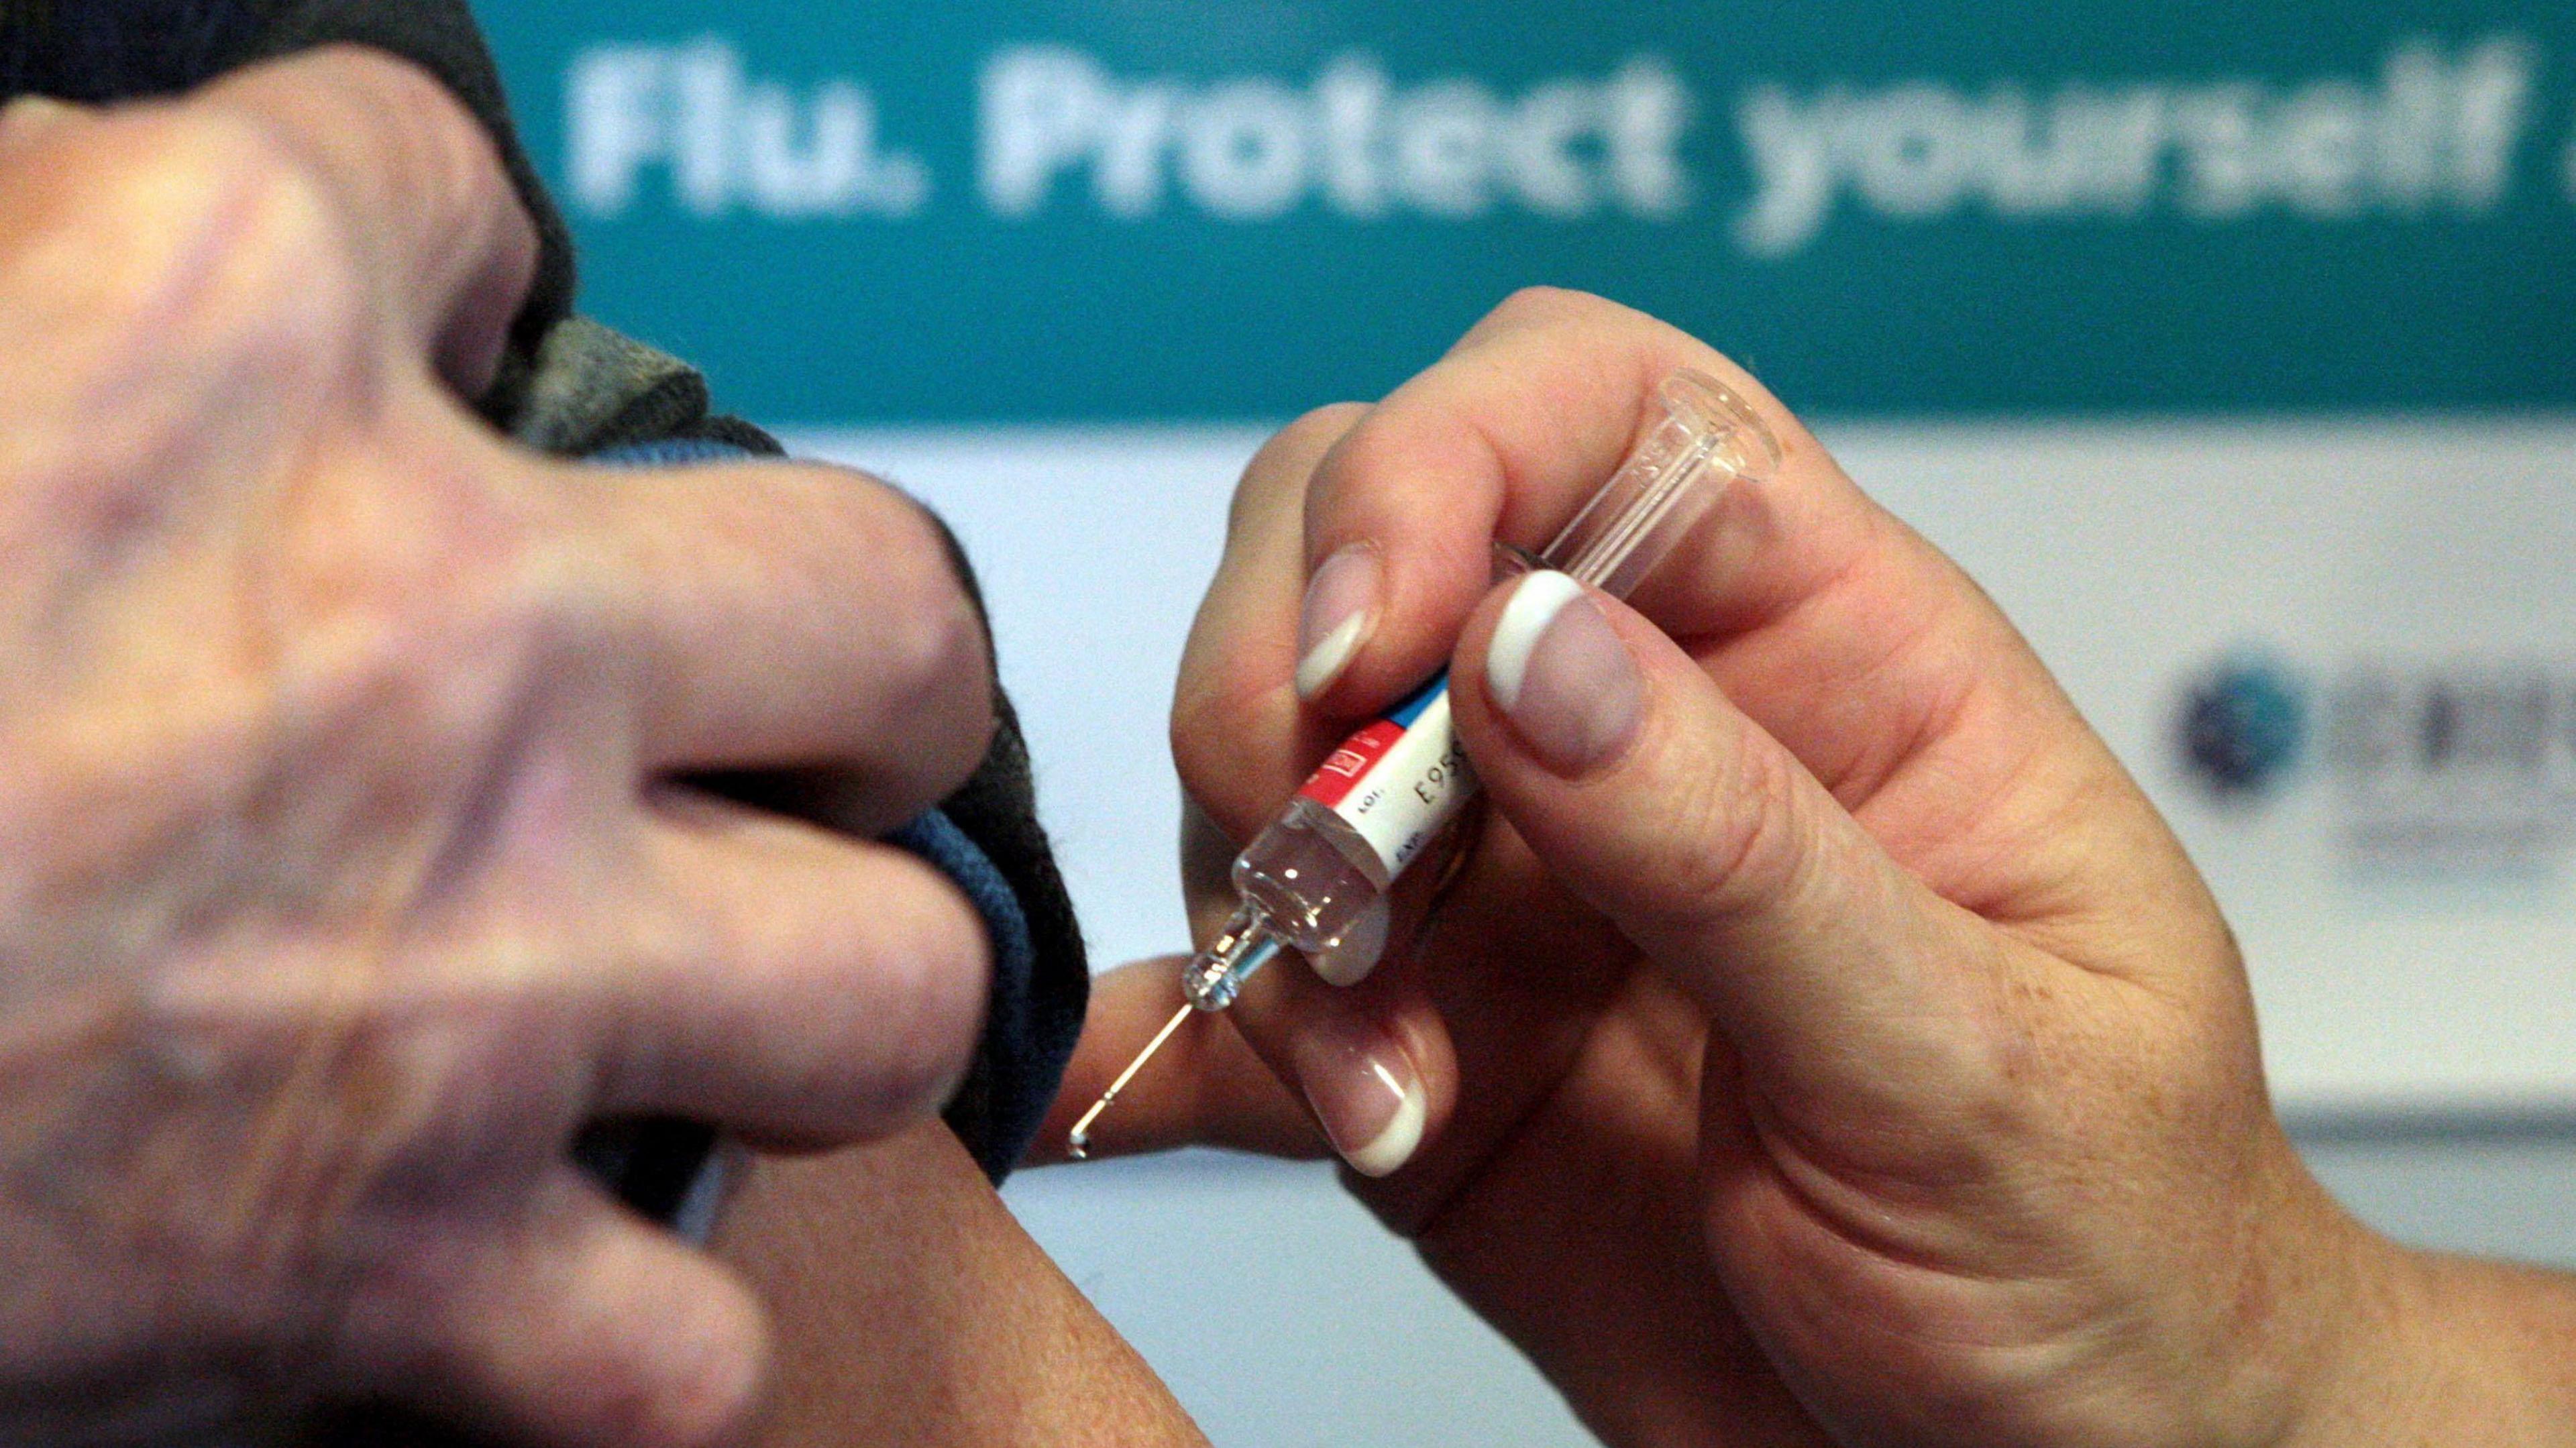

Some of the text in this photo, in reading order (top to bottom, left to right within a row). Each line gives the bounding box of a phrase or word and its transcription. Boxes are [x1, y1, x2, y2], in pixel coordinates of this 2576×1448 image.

[568, 40, 926, 216] Flu.
[983, 48, 1685, 217] Protect
[1739, 40, 2528, 256] yourself
